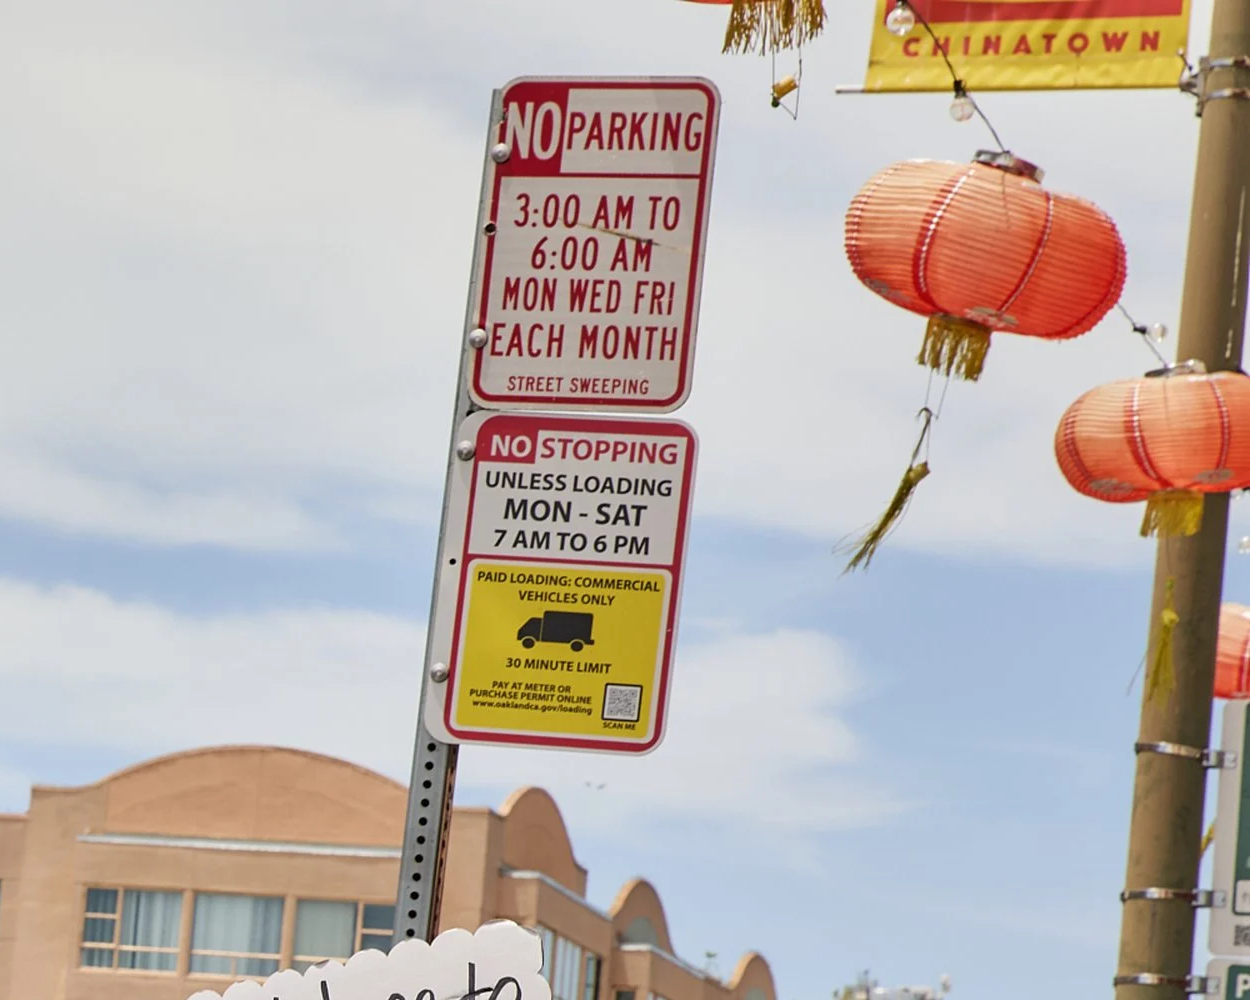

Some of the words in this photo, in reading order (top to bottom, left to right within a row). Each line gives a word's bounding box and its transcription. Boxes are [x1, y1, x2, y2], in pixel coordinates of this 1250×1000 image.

[903, 30, 1160, 57] CHINATOWN
[505, 101, 562, 160] NO
[566, 112, 704, 152] PARKING
[514, 193, 581, 229] 3:00
[592, 195, 633, 230] AM
[648, 196, 680, 231] TO
[531, 236, 599, 271] 6:00
[610, 238, 654, 273] AM
[502, 277, 557, 312] MON
[569, 279, 621, 314] WED
[634, 281, 675, 315] FRI
[490, 323, 565, 358] EACH
[578, 325, 677, 361] MONTH
[507, 376, 564, 393] STREET
[570, 378, 649, 395] SWEEPING
[490, 435, 532, 458] NO
[540, 438, 678, 464] STOPPING
[485, 471, 567, 491] UNLESS
[573, 476, 672, 497] LOADING
[503, 499, 572, 522] MON
[595, 503, 647, 527] SAT
[493, 530, 507, 547] 7
[512, 531, 550, 550] AM
[557, 533, 587, 552] TO
[593, 535, 607, 553] 6
[614, 536, 650, 555] PM
[477, 571, 507, 583] PAID
[510, 573, 572, 587] LOADING:
[574, 577, 660, 592] COMMERCIAL
[518, 590, 579, 604] VEHICLES
[581, 594, 615, 606] ONLY
[505, 658, 521, 669] 30
[524, 659, 574, 672] MINUTE
[577, 662, 612, 674] LIMIT
[470, 689, 518, 699] PURCHASE
[521, 692, 555, 701] PERMIT
[557, 695, 592, 704] ONLINE
[492, 681, 509, 689] PAY
[511, 682, 523, 690] AT
[525, 684, 556, 692] METER
[558, 685, 571, 693] OR
[603, 722, 623, 730] SCAN
